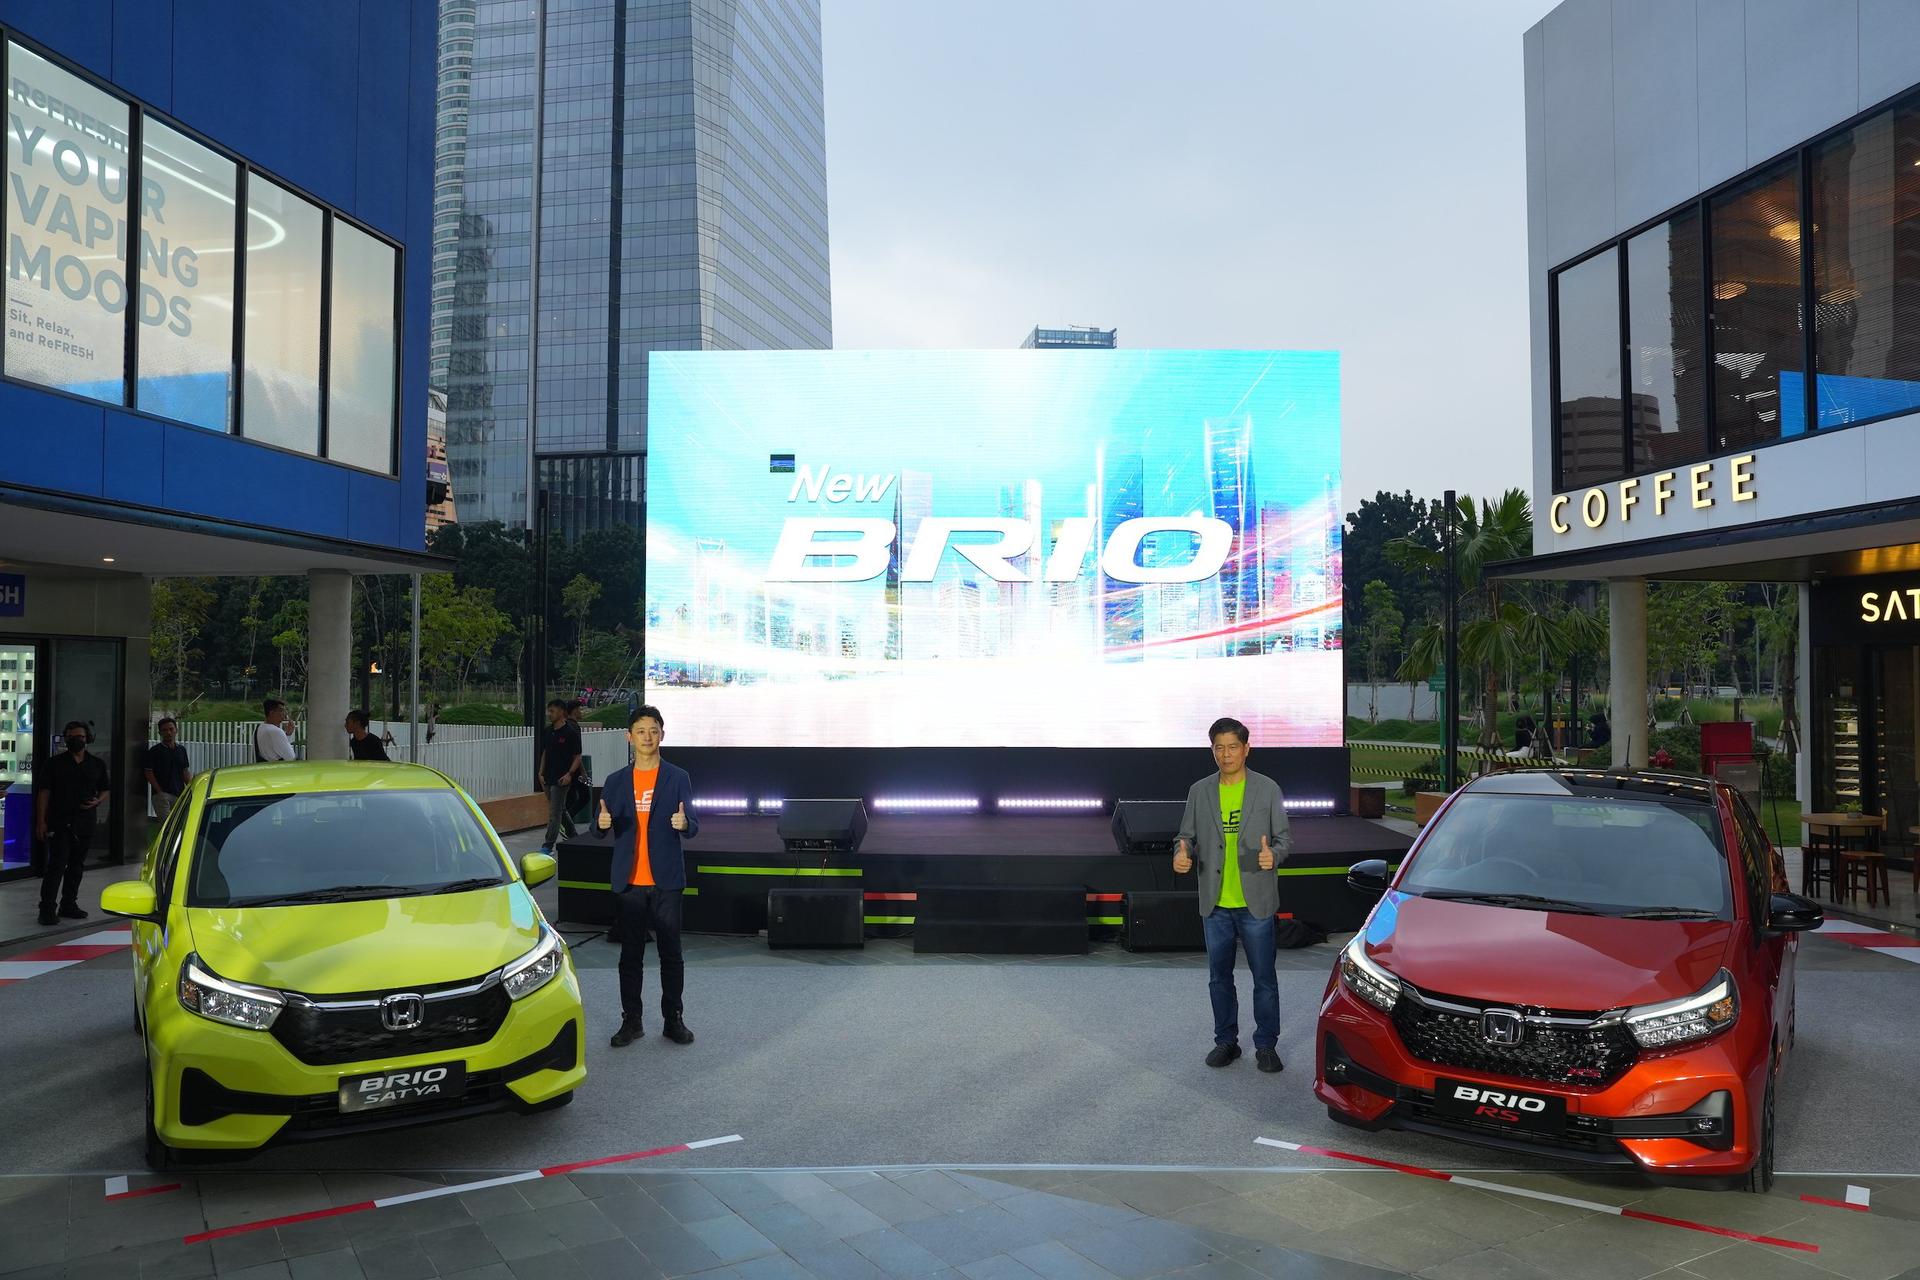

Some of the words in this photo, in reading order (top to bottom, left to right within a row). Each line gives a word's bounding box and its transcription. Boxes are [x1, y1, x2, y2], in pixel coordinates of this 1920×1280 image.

[9, 112, 165, 224] YOUR
[10, 171, 199, 288] VAPING
[10, 232, 192, 337] MOODS
[9, 328, 34, 343] and
[10, 308, 32, 327] Sit,
[36, 316, 74, 340] Relax,
[787, 463, 897, 503] New
[1550, 454, 1757, 534] COFFEE
[765, 516, 1234, 583] BRIO
[359, 1067, 448, 1093] BRIO
[364, 1084, 441, 1105] SATYA
[1453, 1086, 1546, 1113] BRIO
[1474, 1105, 1521, 1123] RS
